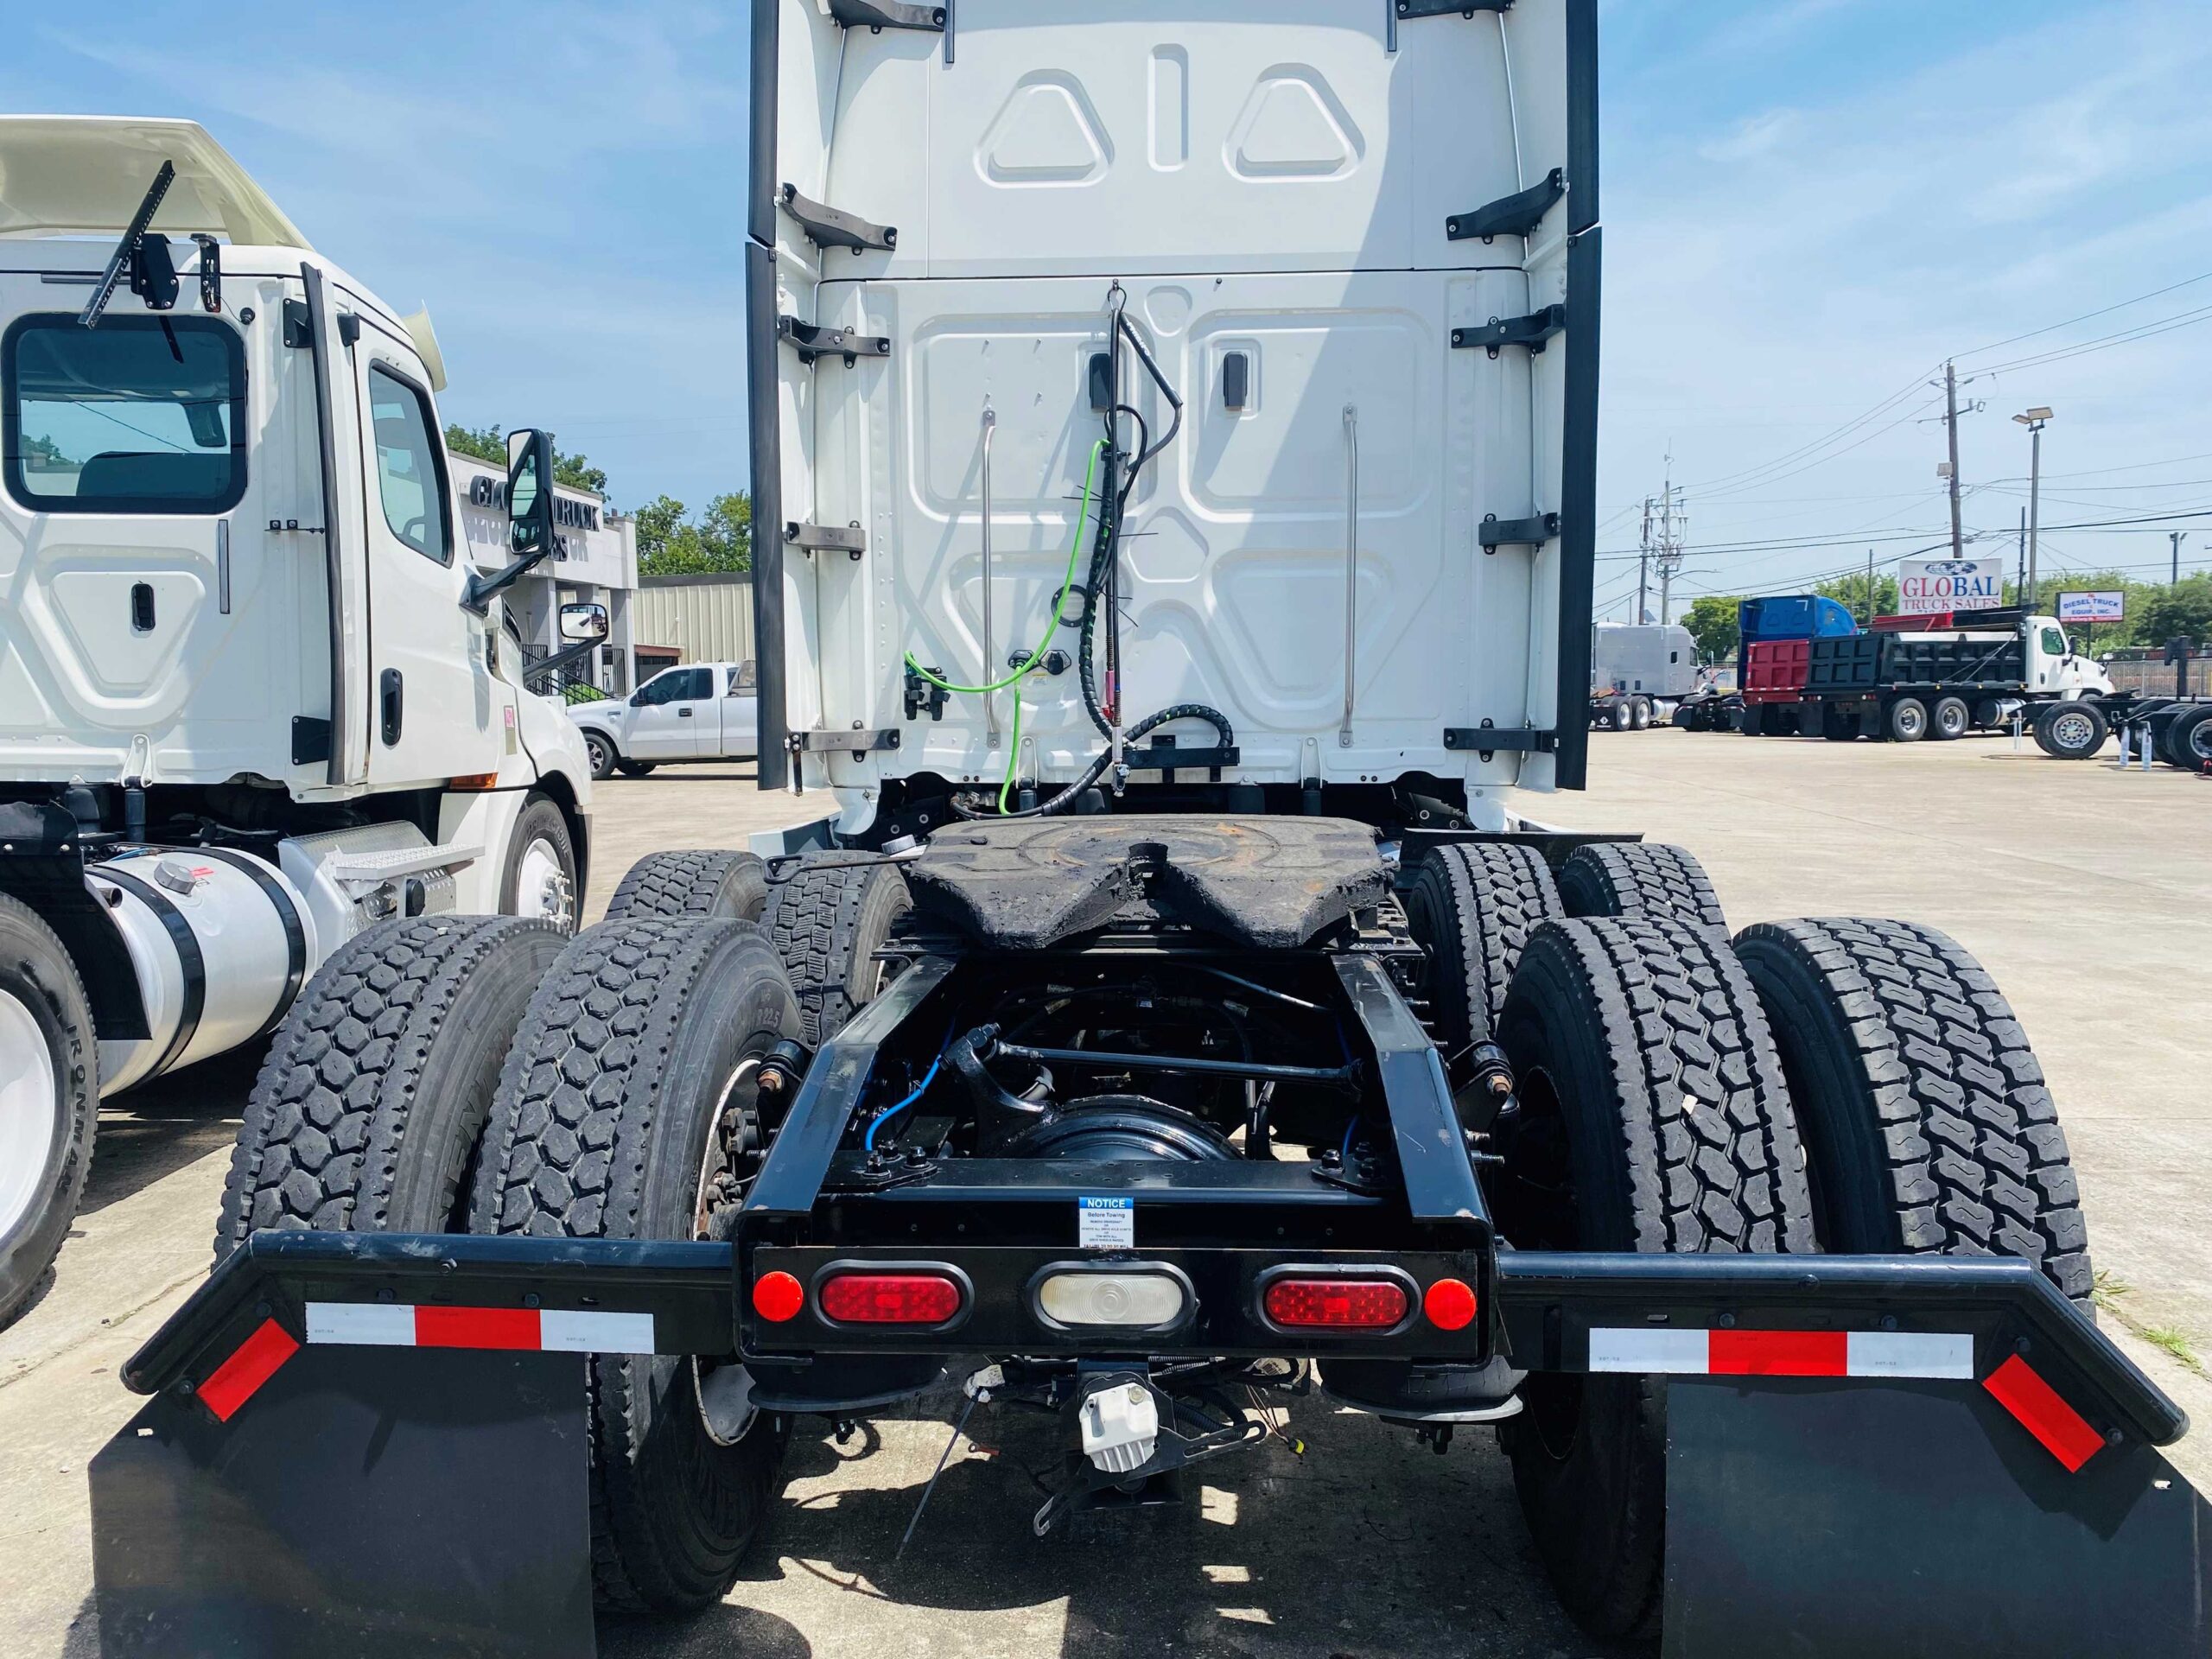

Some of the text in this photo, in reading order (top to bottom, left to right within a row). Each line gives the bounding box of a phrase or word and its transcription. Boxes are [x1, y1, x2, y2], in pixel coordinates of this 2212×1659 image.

[470, 475, 600, 532] GLO TRUCK
[1903, 576, 1999, 597] GLOBAL
[1903, 598, 1999, 609] TRUCK SALES
[2063, 599, 2091, 609] DIESEL
[2093, 598, 2120, 607] TRUCK
[58, 1024, 86, 1196] IRONMAN
[1087, 1198, 1126, 1208] NOTICE
